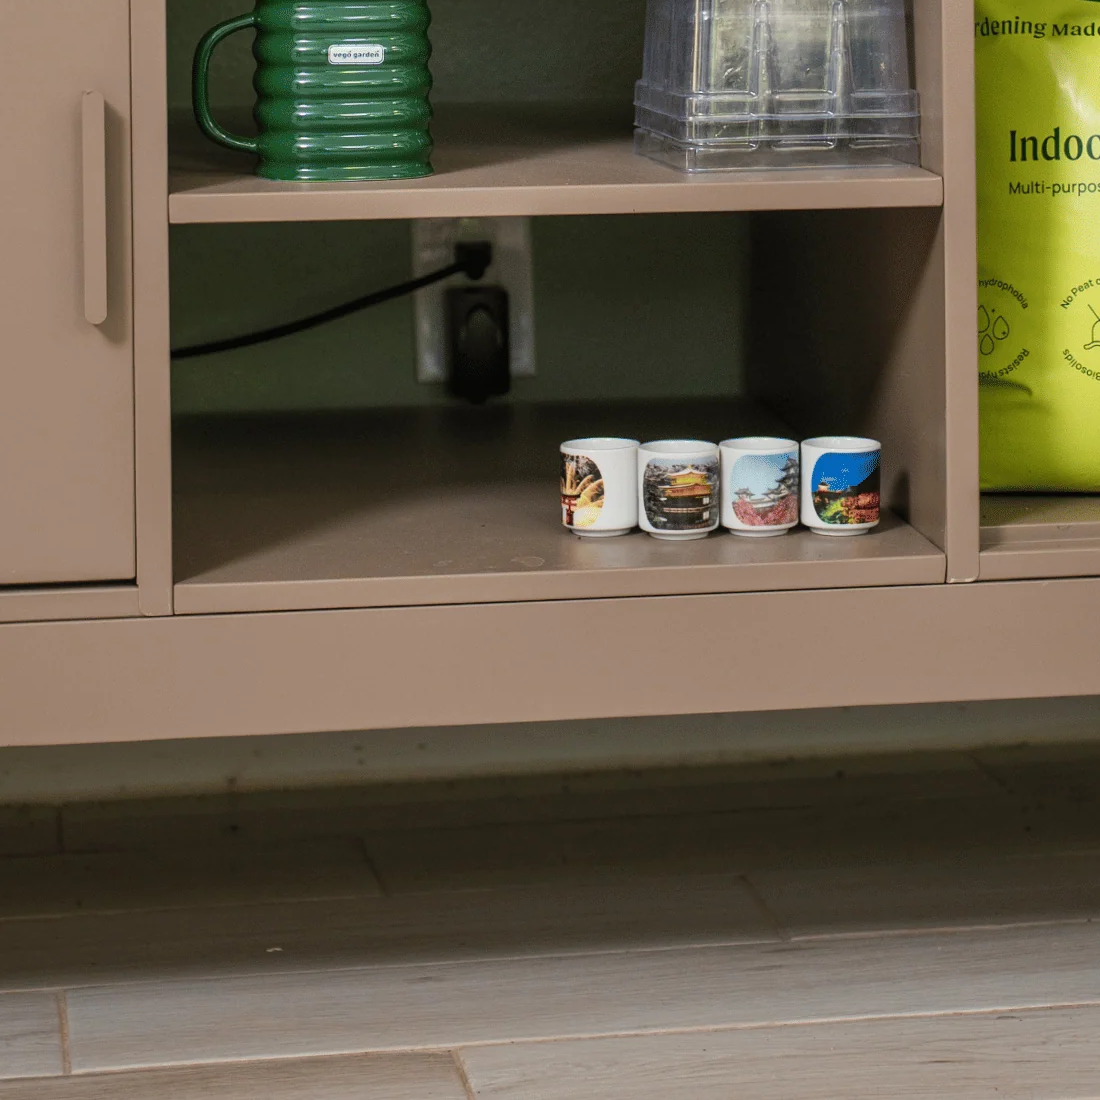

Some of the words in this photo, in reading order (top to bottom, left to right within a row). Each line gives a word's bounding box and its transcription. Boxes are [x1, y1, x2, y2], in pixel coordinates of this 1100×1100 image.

[1060, 295, 1073, 310] No
[1070, 280, 1094, 297] Peat
[998, 348, 1030, 376] Resists
